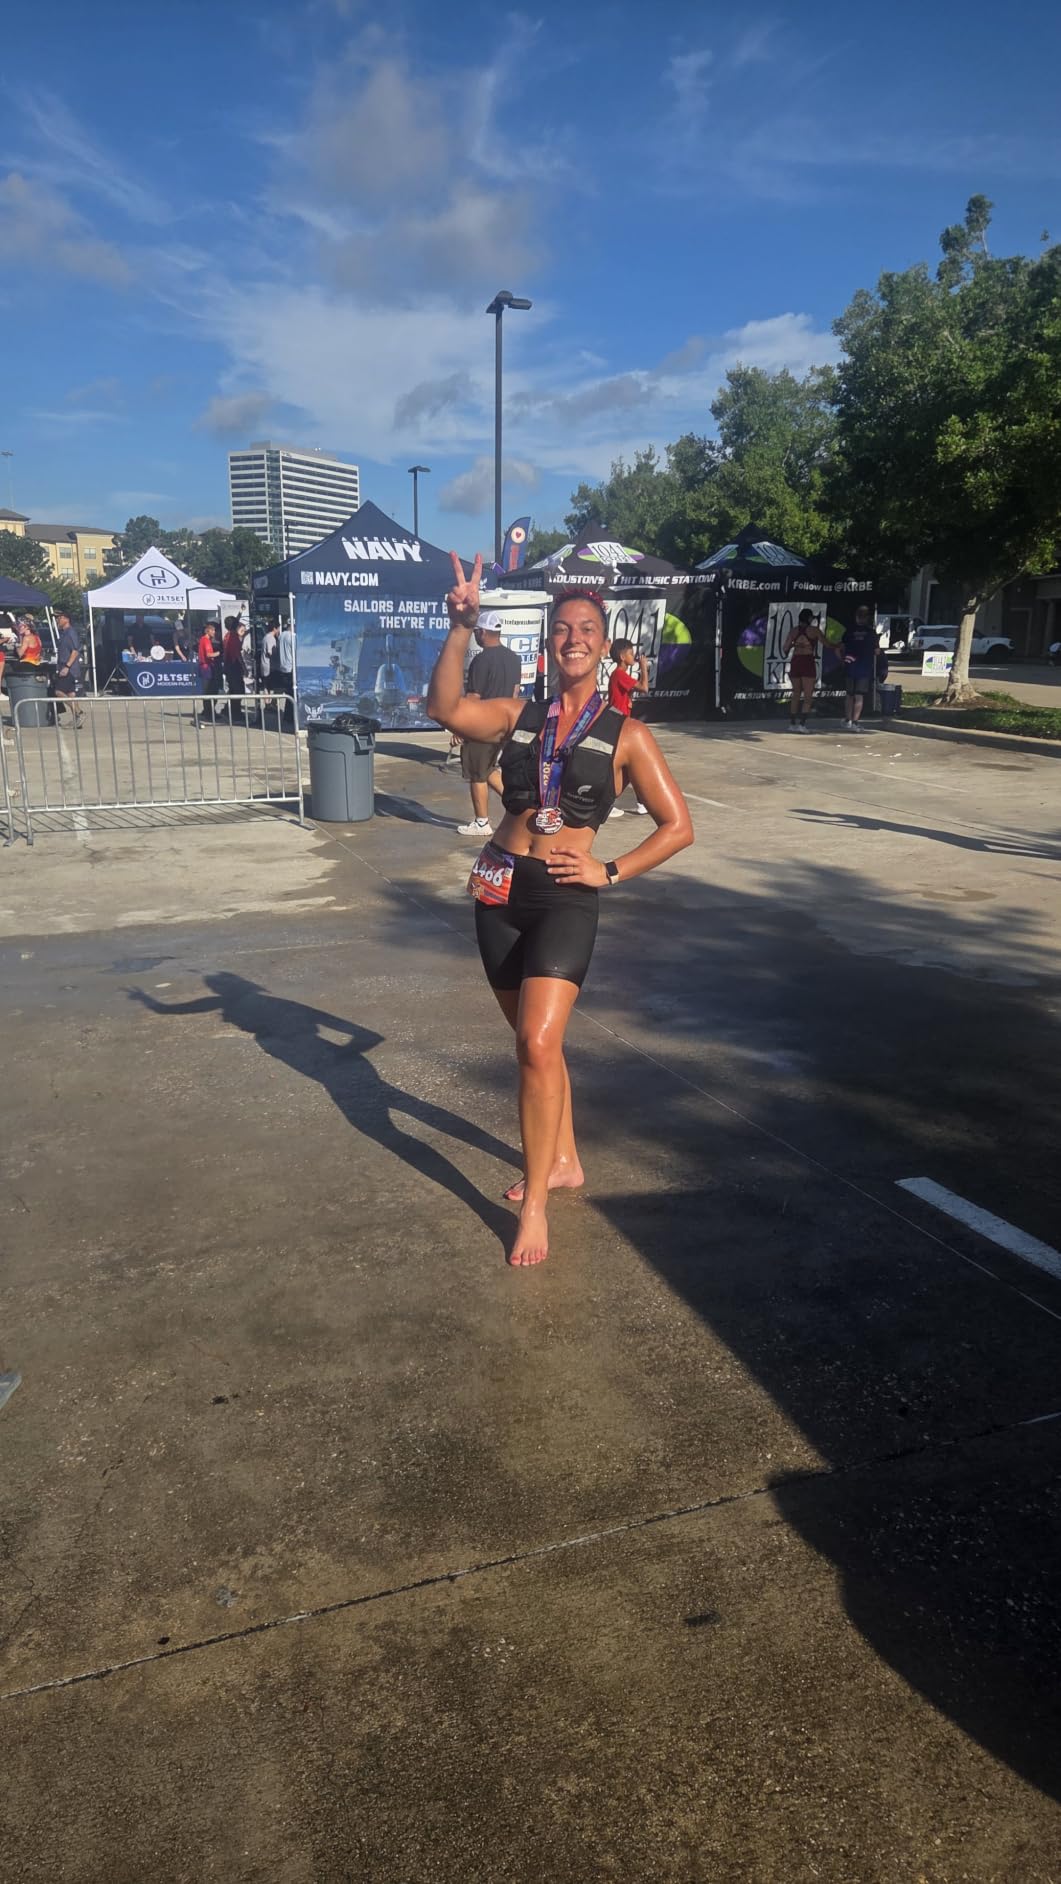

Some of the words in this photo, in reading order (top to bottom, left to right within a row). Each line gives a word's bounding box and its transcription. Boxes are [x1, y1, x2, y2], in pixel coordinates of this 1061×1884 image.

[341, 540, 424, 563] NAVY
[315, 571, 379, 587] NAVY.COM
[620, 576, 638, 585] HIT
[639, 575, 671, 585] MUSIC
[671, 573, 716, 585] STATION!
[727, 578, 781, 591] KRBE.com
[793, 581, 822, 592] Follow
[823, 584, 833, 592] us
[344, 600, 394, 613] SAILORS
[398, 601, 438, 614] AREN'T
[379, 615, 425, 629] THEY'RE
[428, 617, 451, 630] FOR
[766, 609, 822, 660] 101
